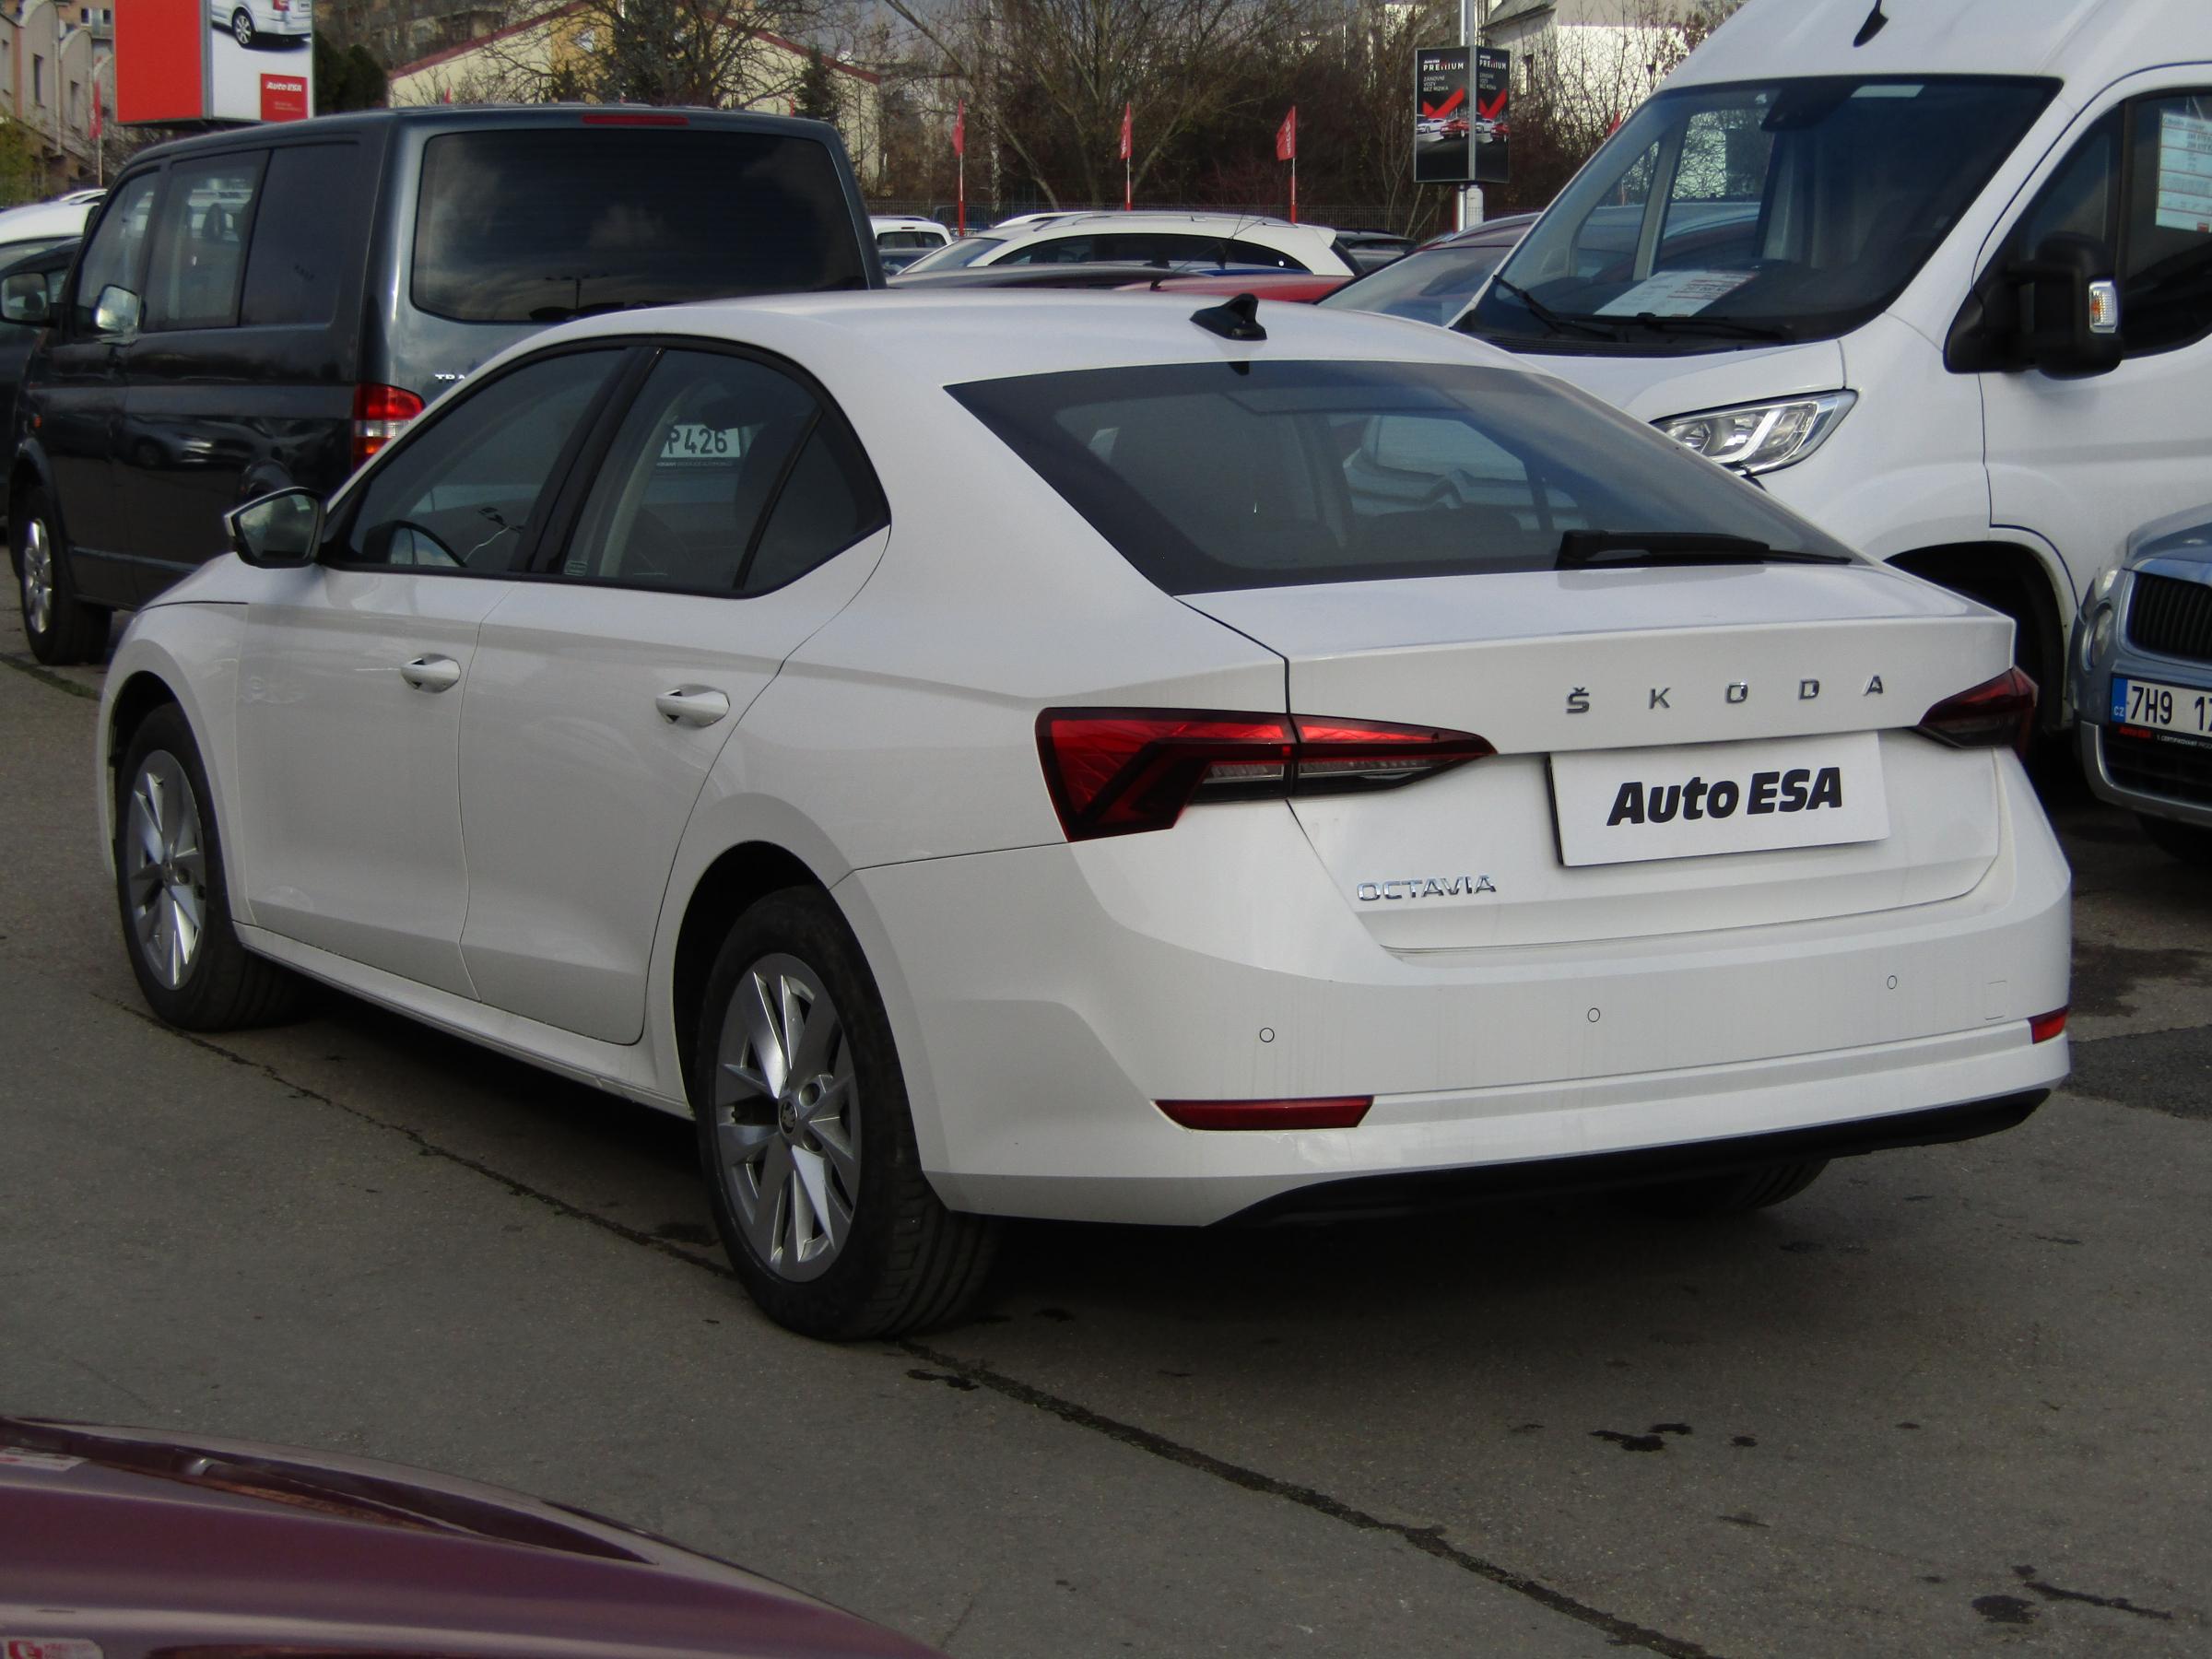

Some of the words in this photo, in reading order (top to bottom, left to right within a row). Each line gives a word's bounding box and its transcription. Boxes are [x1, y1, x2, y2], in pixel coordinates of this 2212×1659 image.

[1423, 62, 1464, 71] PREMIUM
[1479, 59, 1506, 70] PREMIUM
[266, 81, 288, 90] Auto
[288, 83, 302, 91] ESA
[1566, 676, 1884, 713] ŠKODA
[2113, 706, 2124, 717] CZ
[2130, 686, 2172, 724] 7H9
[1606, 777, 1739, 827] Auto
[1747, 767, 1842, 815] ESA
[1357, 875, 1497, 901] OCTAVIA
